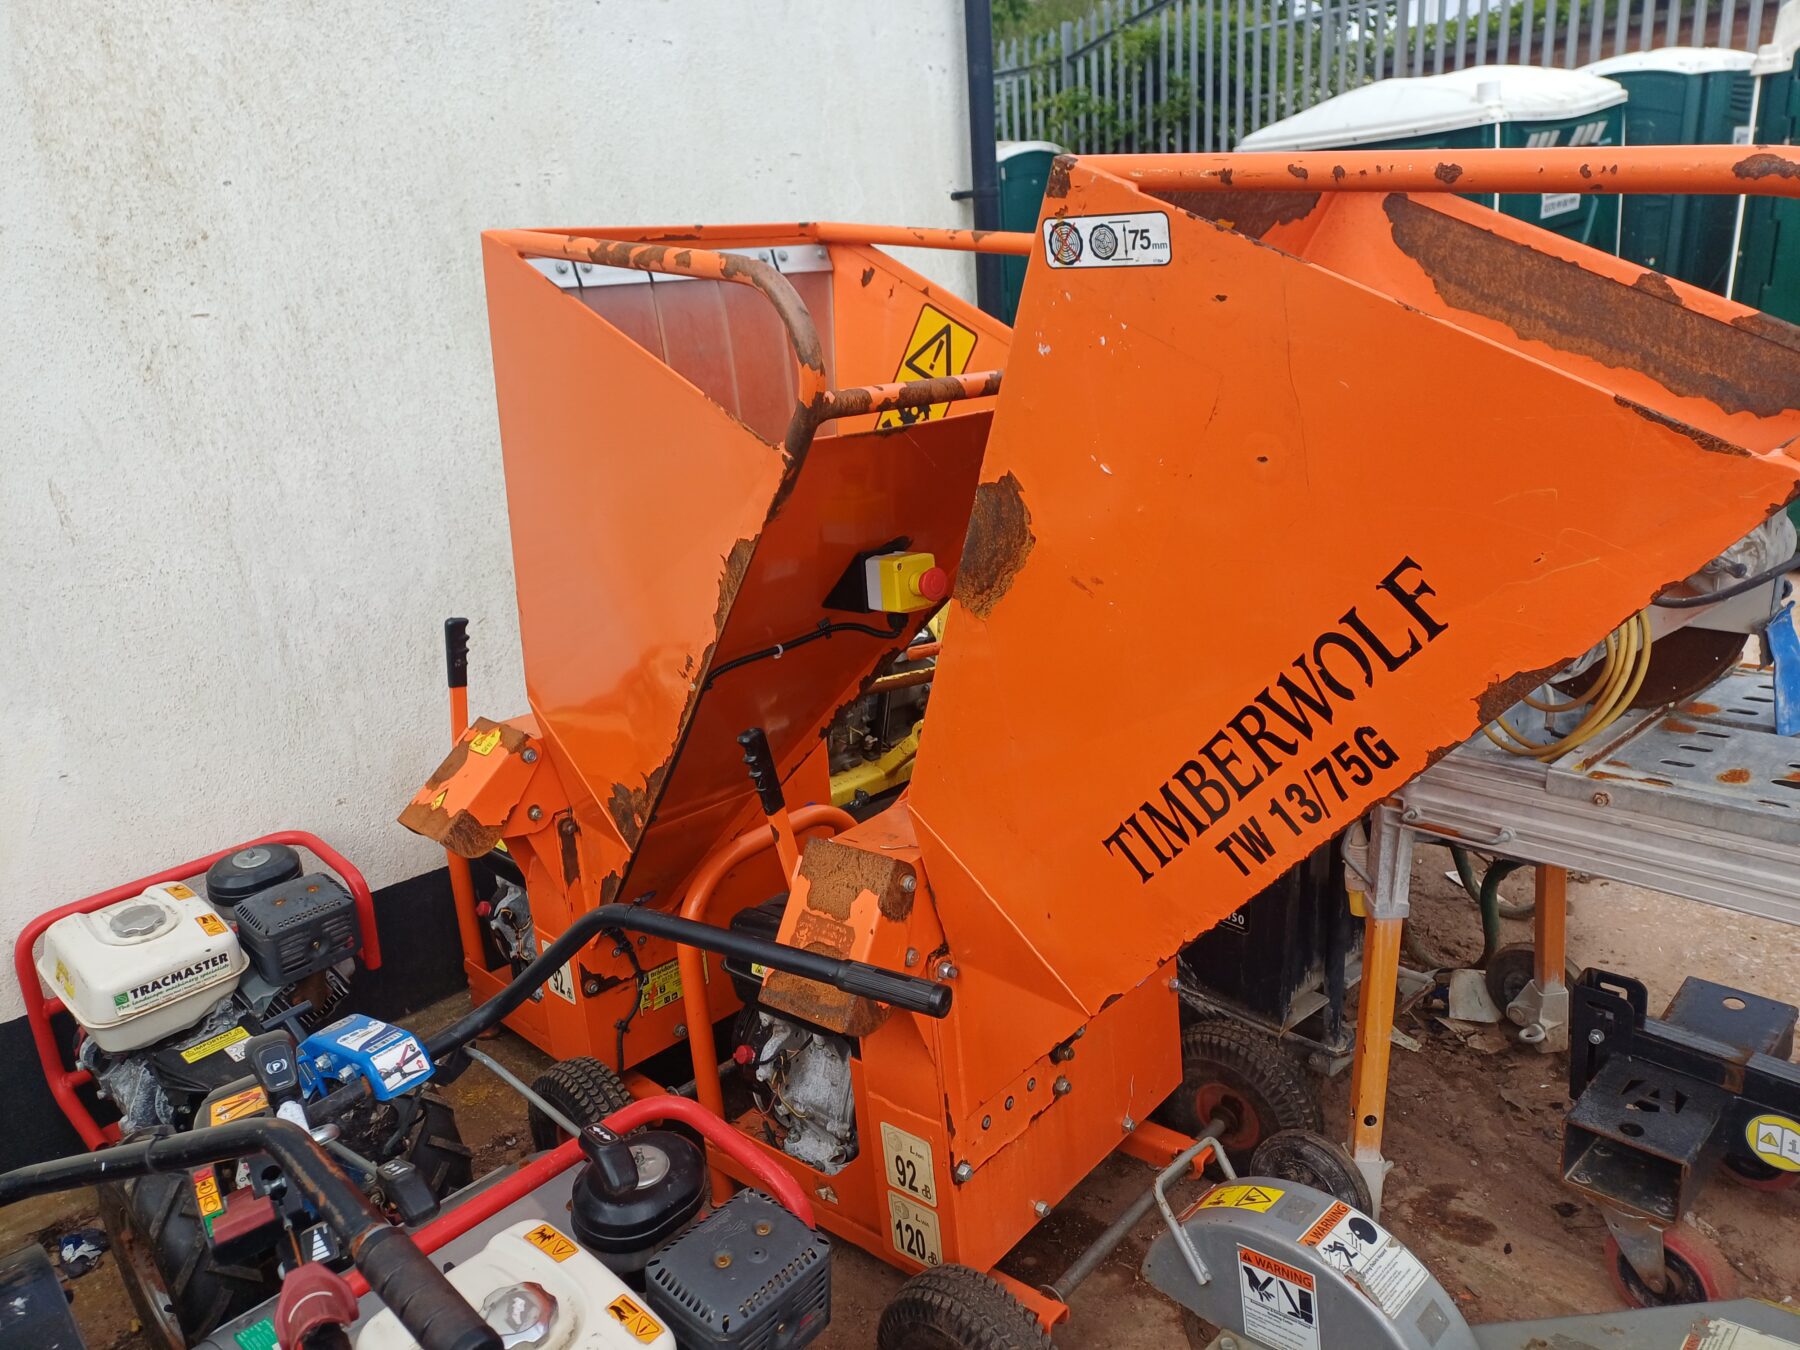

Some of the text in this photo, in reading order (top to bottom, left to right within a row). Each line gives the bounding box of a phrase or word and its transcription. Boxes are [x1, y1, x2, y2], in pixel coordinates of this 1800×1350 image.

[1101, 555, 1449, 884] TIMBERWOLF
[1214, 726, 1400, 877] TW 13/75G
[130, 952, 229, 1000] TRACMASTER
[193, 1031, 234, 1053] IMPORTANT
[895, 1154, 919, 1193] 92
[895, 1219, 926, 1260] 120
[1310, 1204, 1348, 1240] WARNING
[1254, 1256, 1312, 1288] WARNING
